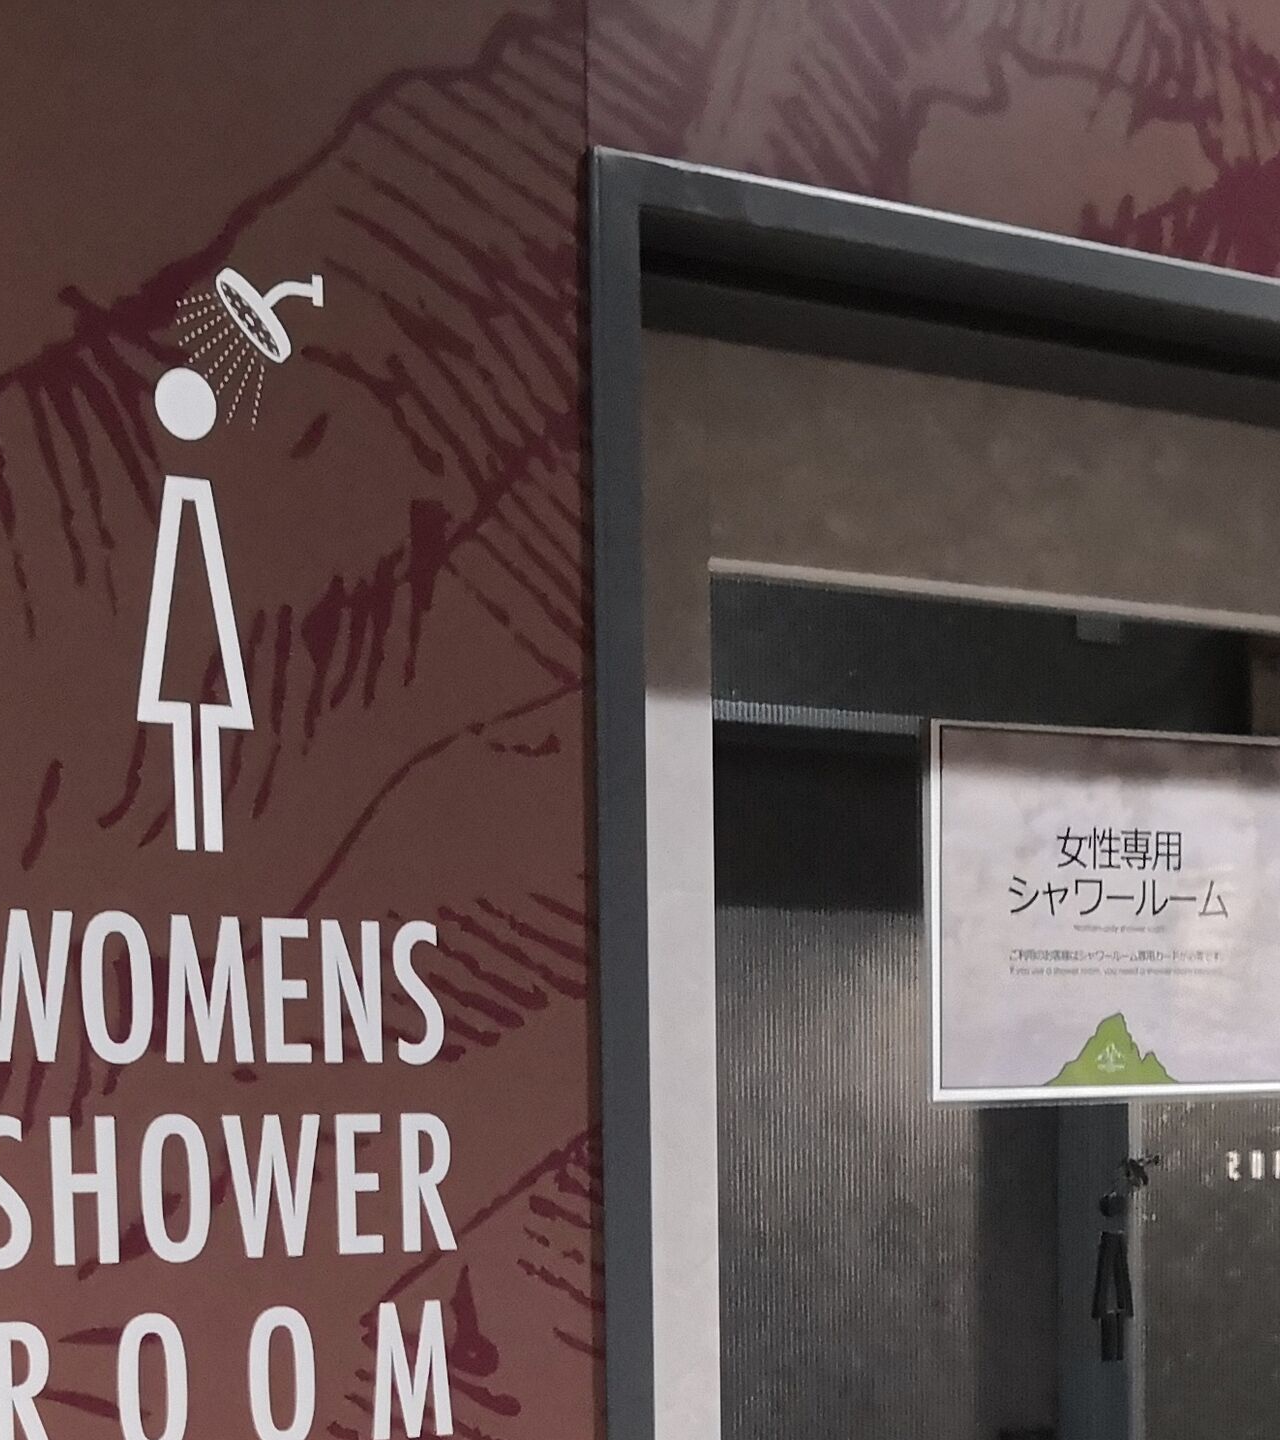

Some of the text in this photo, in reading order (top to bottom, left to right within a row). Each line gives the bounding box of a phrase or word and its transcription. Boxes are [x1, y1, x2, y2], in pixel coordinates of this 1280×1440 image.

[1056, 826, 1182, 872] 女性専用
[1008, 875, 1229, 918] シャワールーム
